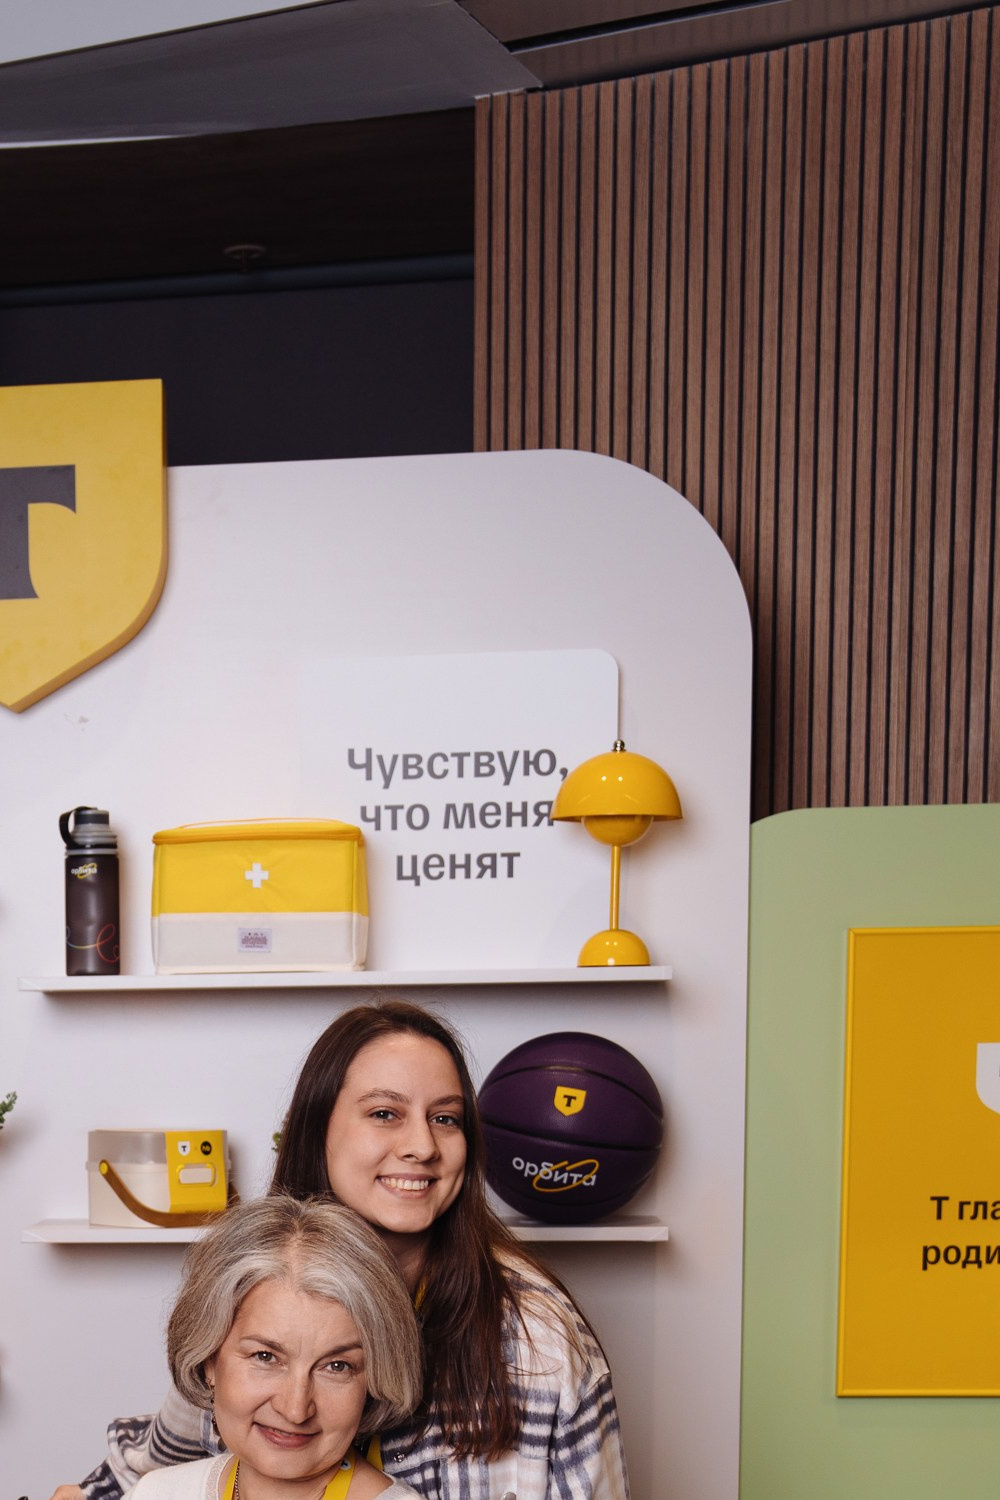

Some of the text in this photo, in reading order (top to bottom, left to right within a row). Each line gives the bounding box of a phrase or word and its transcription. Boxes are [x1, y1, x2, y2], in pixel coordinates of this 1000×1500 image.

[347, 747, 568, 789] Чувствую,
[360, 800, 555, 831] что меня
[396, 851, 521, 886] ценят
[512, 1156, 597, 1187] орбита
[930, 1196, 949, 1220] Т
[922, 1245, 1000, 1271] роди
